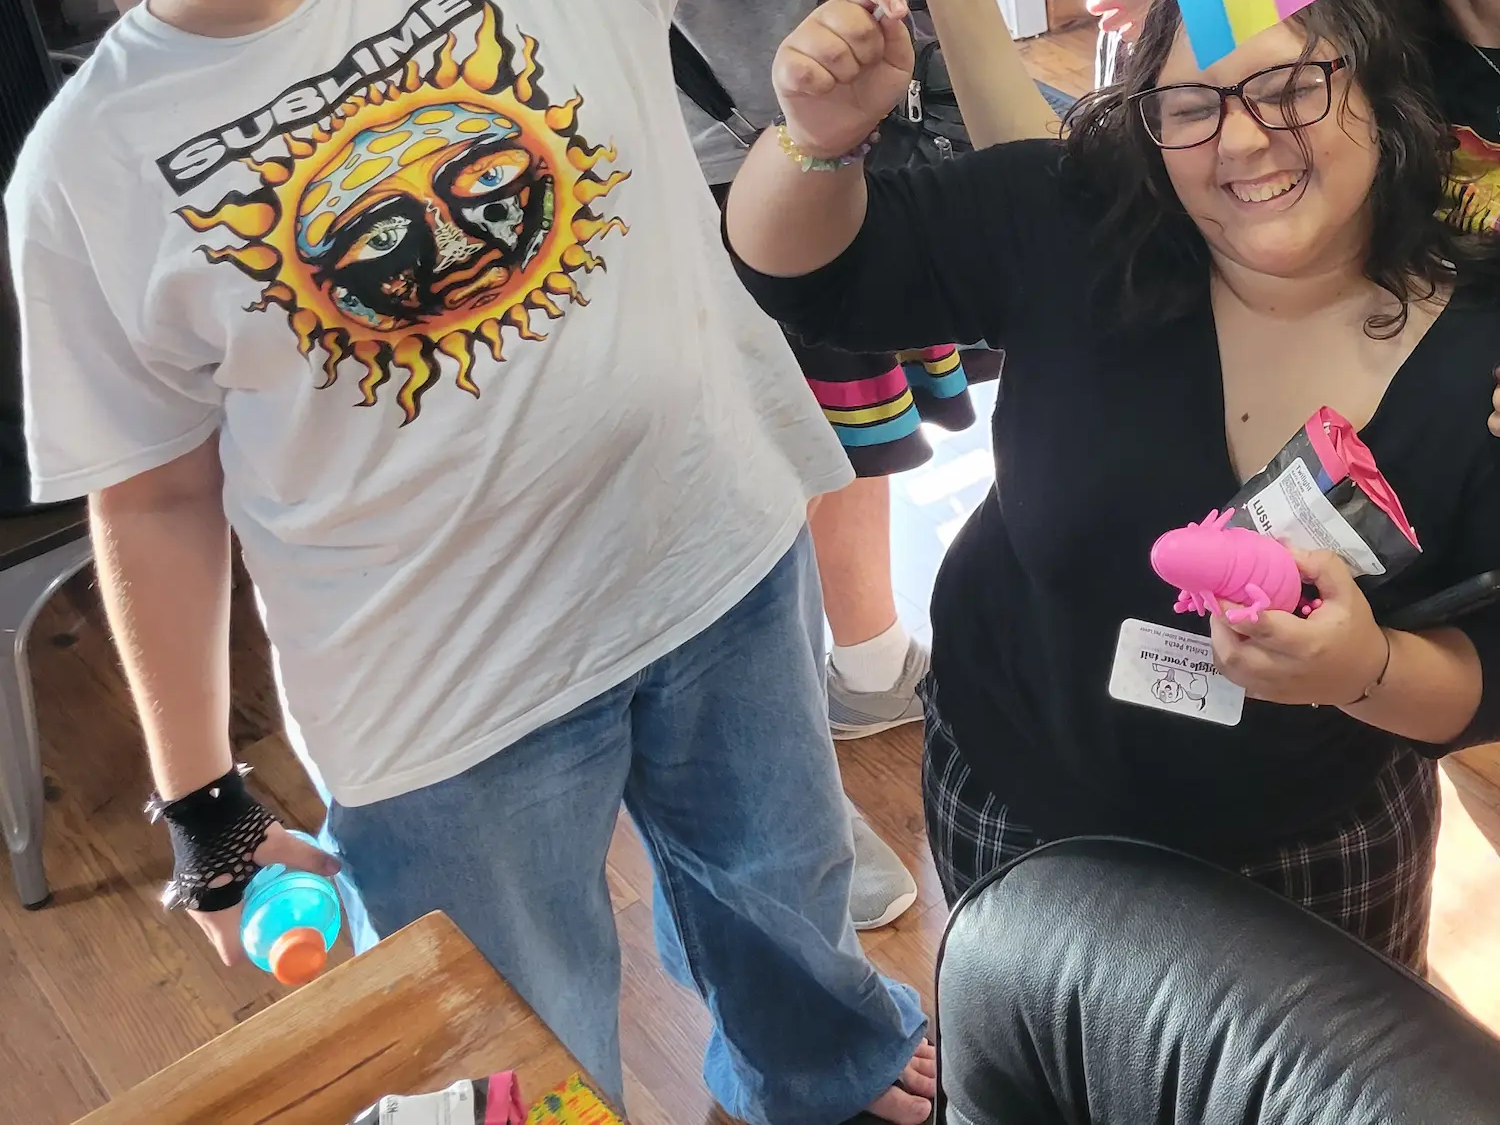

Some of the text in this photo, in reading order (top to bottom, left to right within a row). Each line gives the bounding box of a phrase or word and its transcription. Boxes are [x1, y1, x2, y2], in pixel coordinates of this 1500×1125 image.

[1295, 464, 1312, 492] Twilight
[1252, 499, 1273, 532] LUSH
[1139, 650, 1159, 663] tail
[1160, 655, 1190, 668] your
